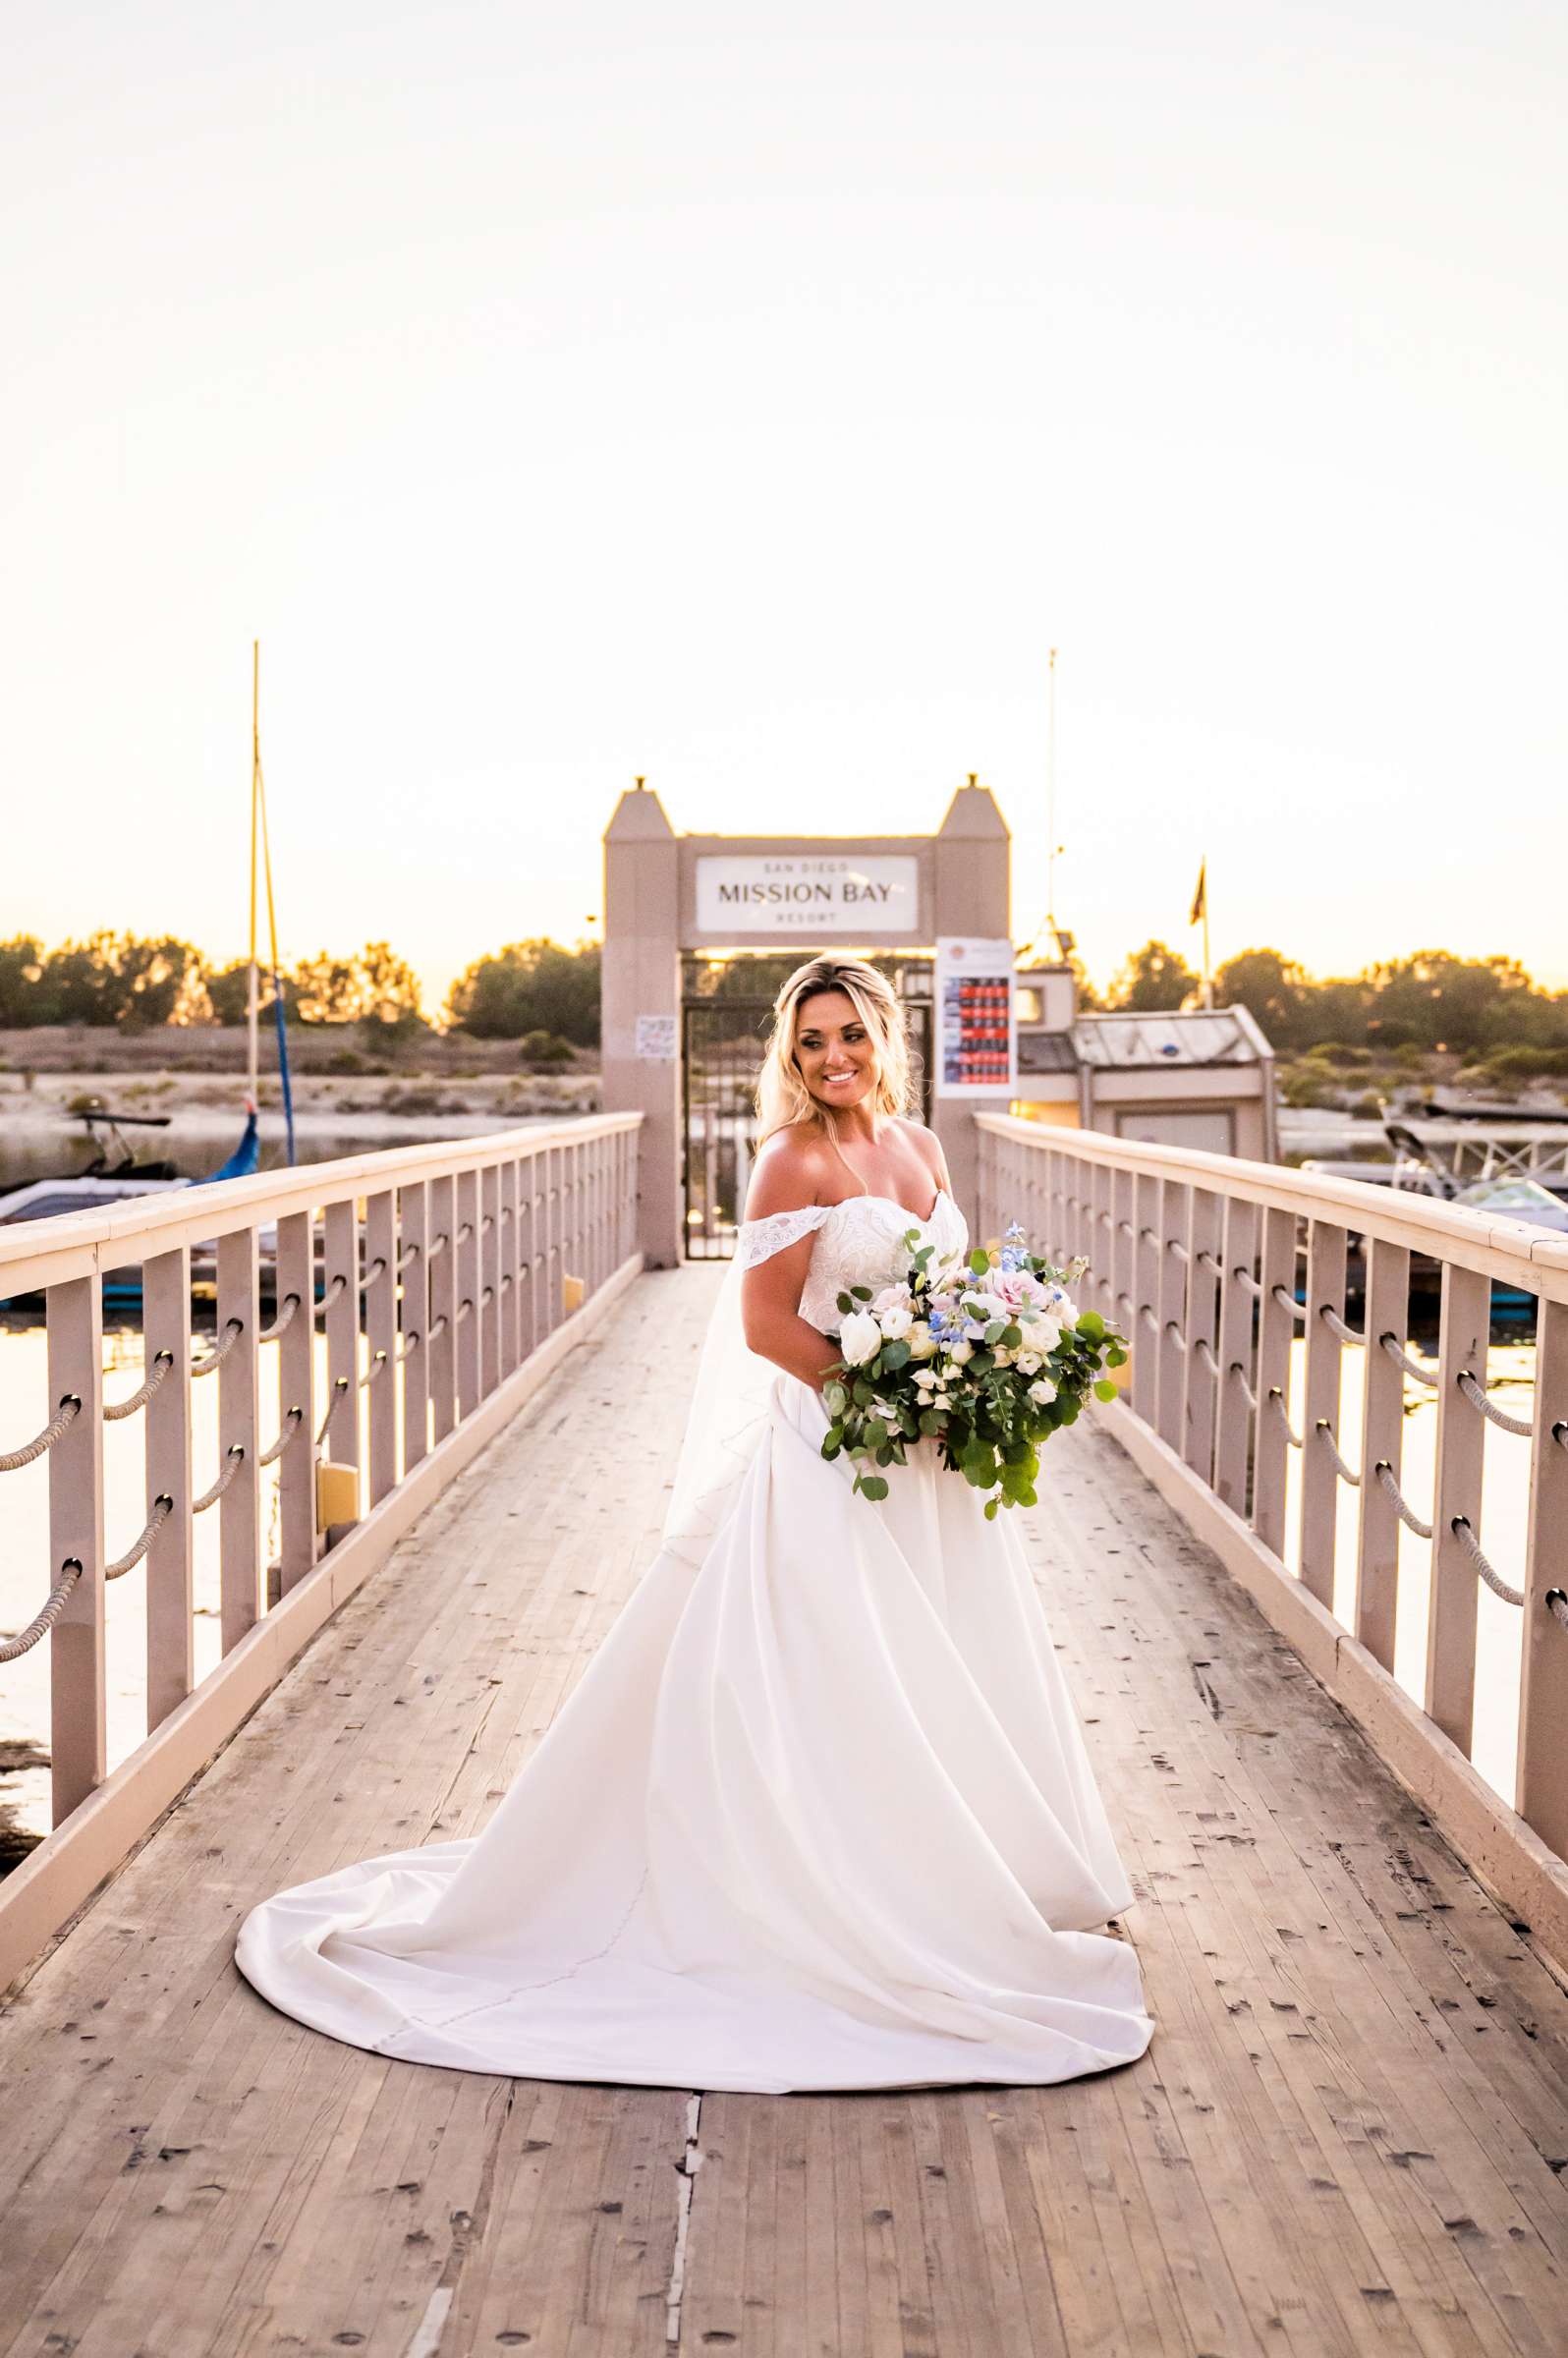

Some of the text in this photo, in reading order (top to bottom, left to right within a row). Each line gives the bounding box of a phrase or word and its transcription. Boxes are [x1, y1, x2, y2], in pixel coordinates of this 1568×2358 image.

[764, 863, 849, 873] SAN DIEGO
[719, 883, 891, 903] MISSION BAY
[776, 913, 837, 923] RESORT
